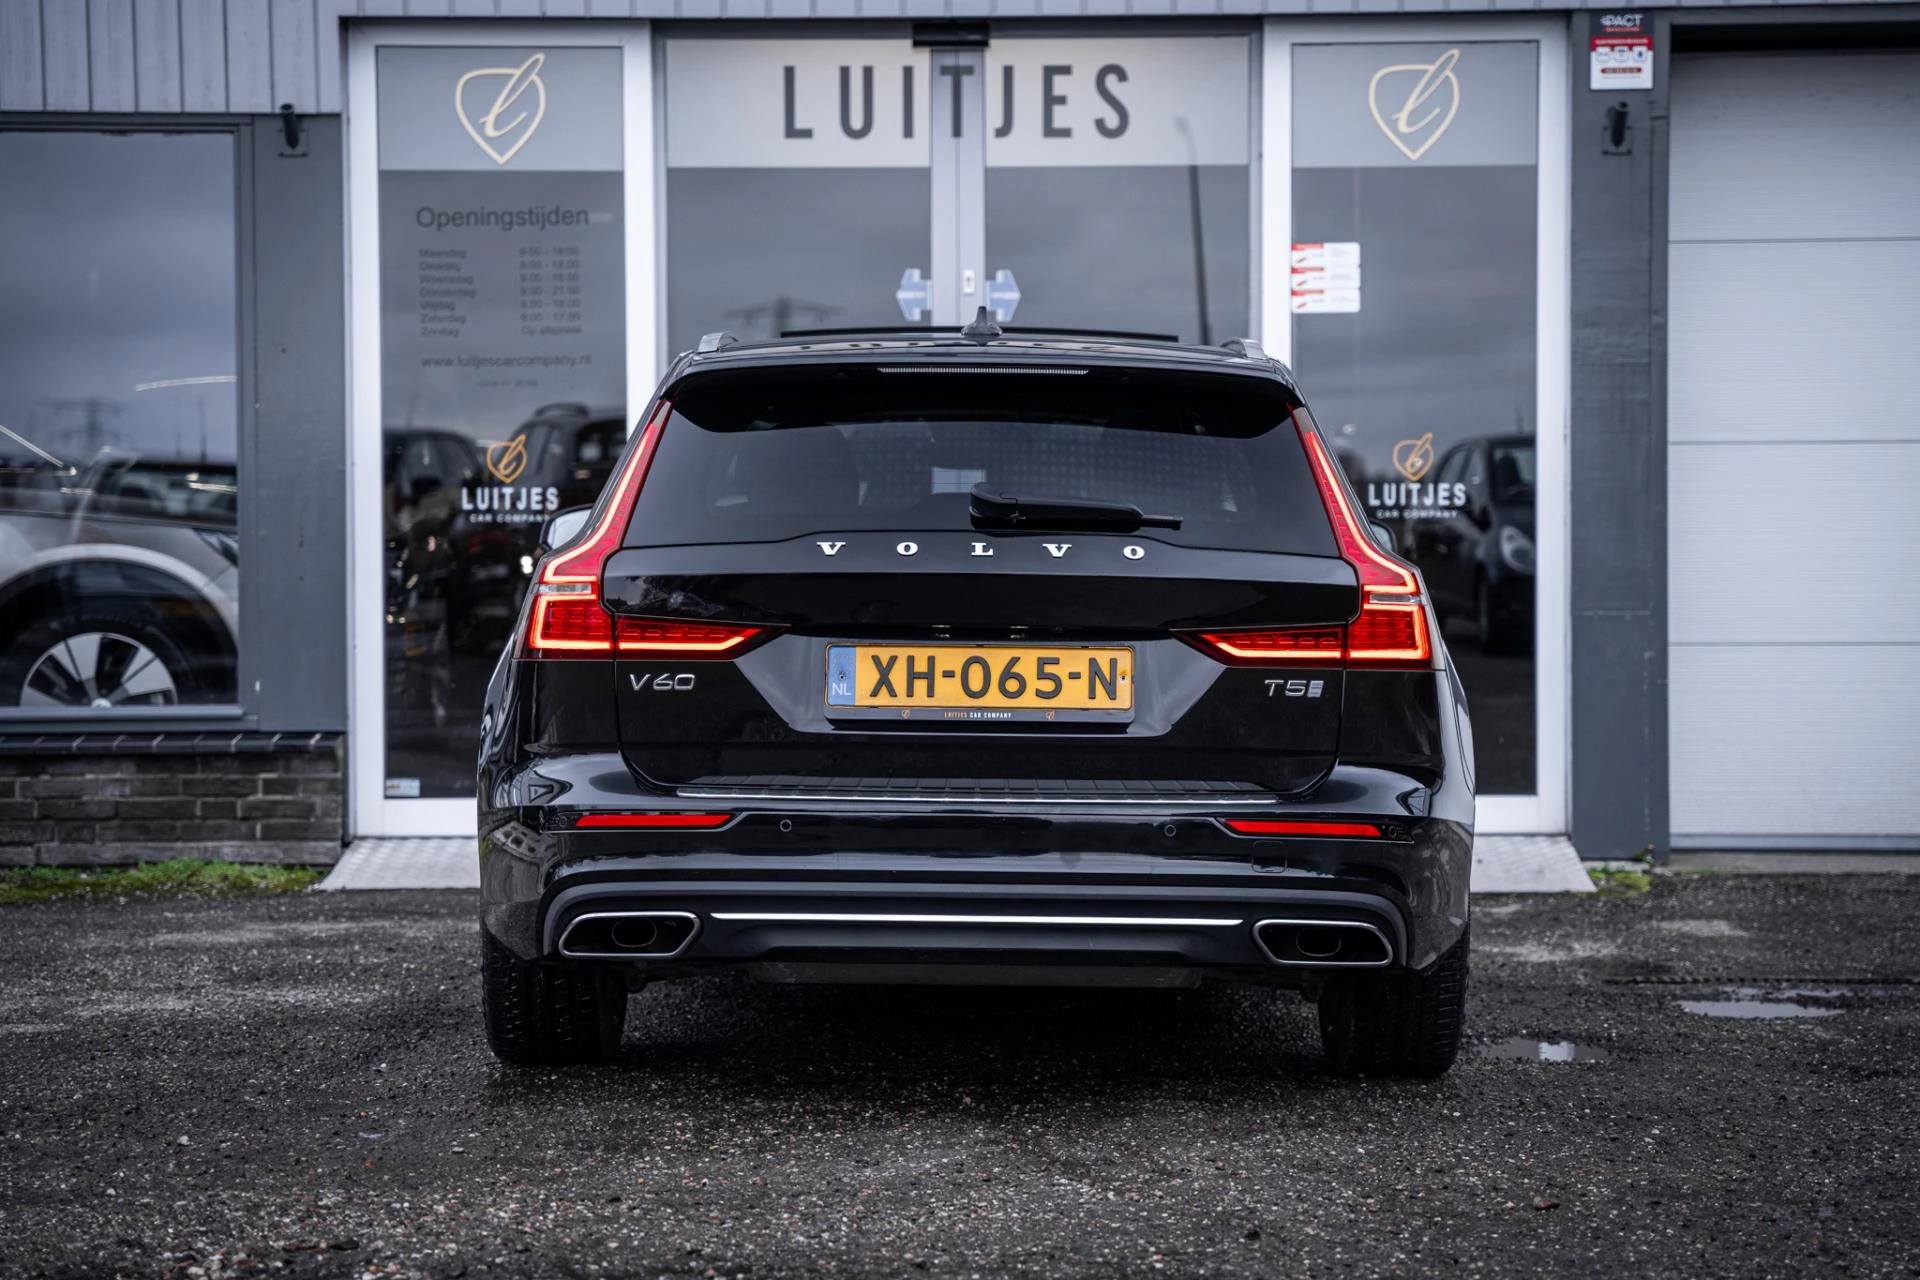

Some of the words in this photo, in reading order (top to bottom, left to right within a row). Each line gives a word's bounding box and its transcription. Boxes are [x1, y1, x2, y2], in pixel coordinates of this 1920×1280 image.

[783, 63, 1131, 139] LUITJES
[416, 204, 590, 232] Openingstijden
[461, 486, 560, 511] LUITJES
[1367, 482, 1467, 507] LUITJES
[815, 540, 1147, 561] VOLVO
[629, 672, 696, 693] V60
[831, 683, 852, 696] NL
[869, 655, 1118, 700] XH-065-N
[969, 711, 982, 719] CAR
[984, 711, 1012, 719] COMPANY
